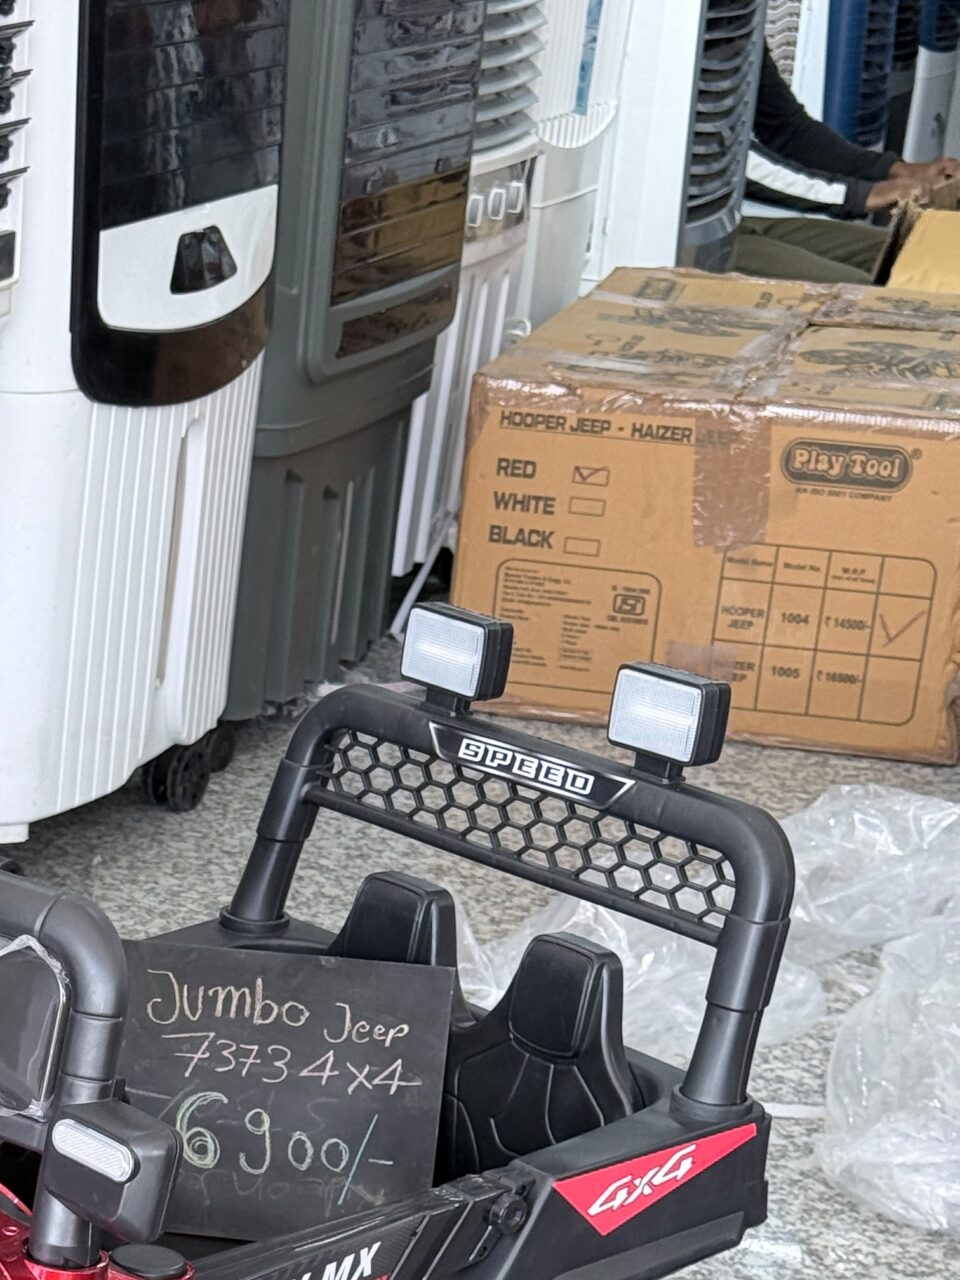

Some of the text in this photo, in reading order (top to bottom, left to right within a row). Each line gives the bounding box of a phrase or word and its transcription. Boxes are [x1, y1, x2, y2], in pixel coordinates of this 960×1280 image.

[499, 410, 567, 432] HOOPER
[569, 417, 611, 434] JEEP
[631, 422, 693, 443] HAIZER
[496, 458, 537, 479] RED
[792, 447, 901, 480] Play Tool
[494, 491, 556, 516] WHITE
[488, 525, 554, 549] BLACK
[721, 605, 765, 618] HOOPER
[781, 612, 809, 626] 1004
[727, 619, 754, 630] JEEP
[771, 666, 800, 679] 1005
[458, 738, 595, 795] SPEED
[147, 969, 409, 1047] Jumbo Jeep
[161, 1032, 291, 1083] 7373
